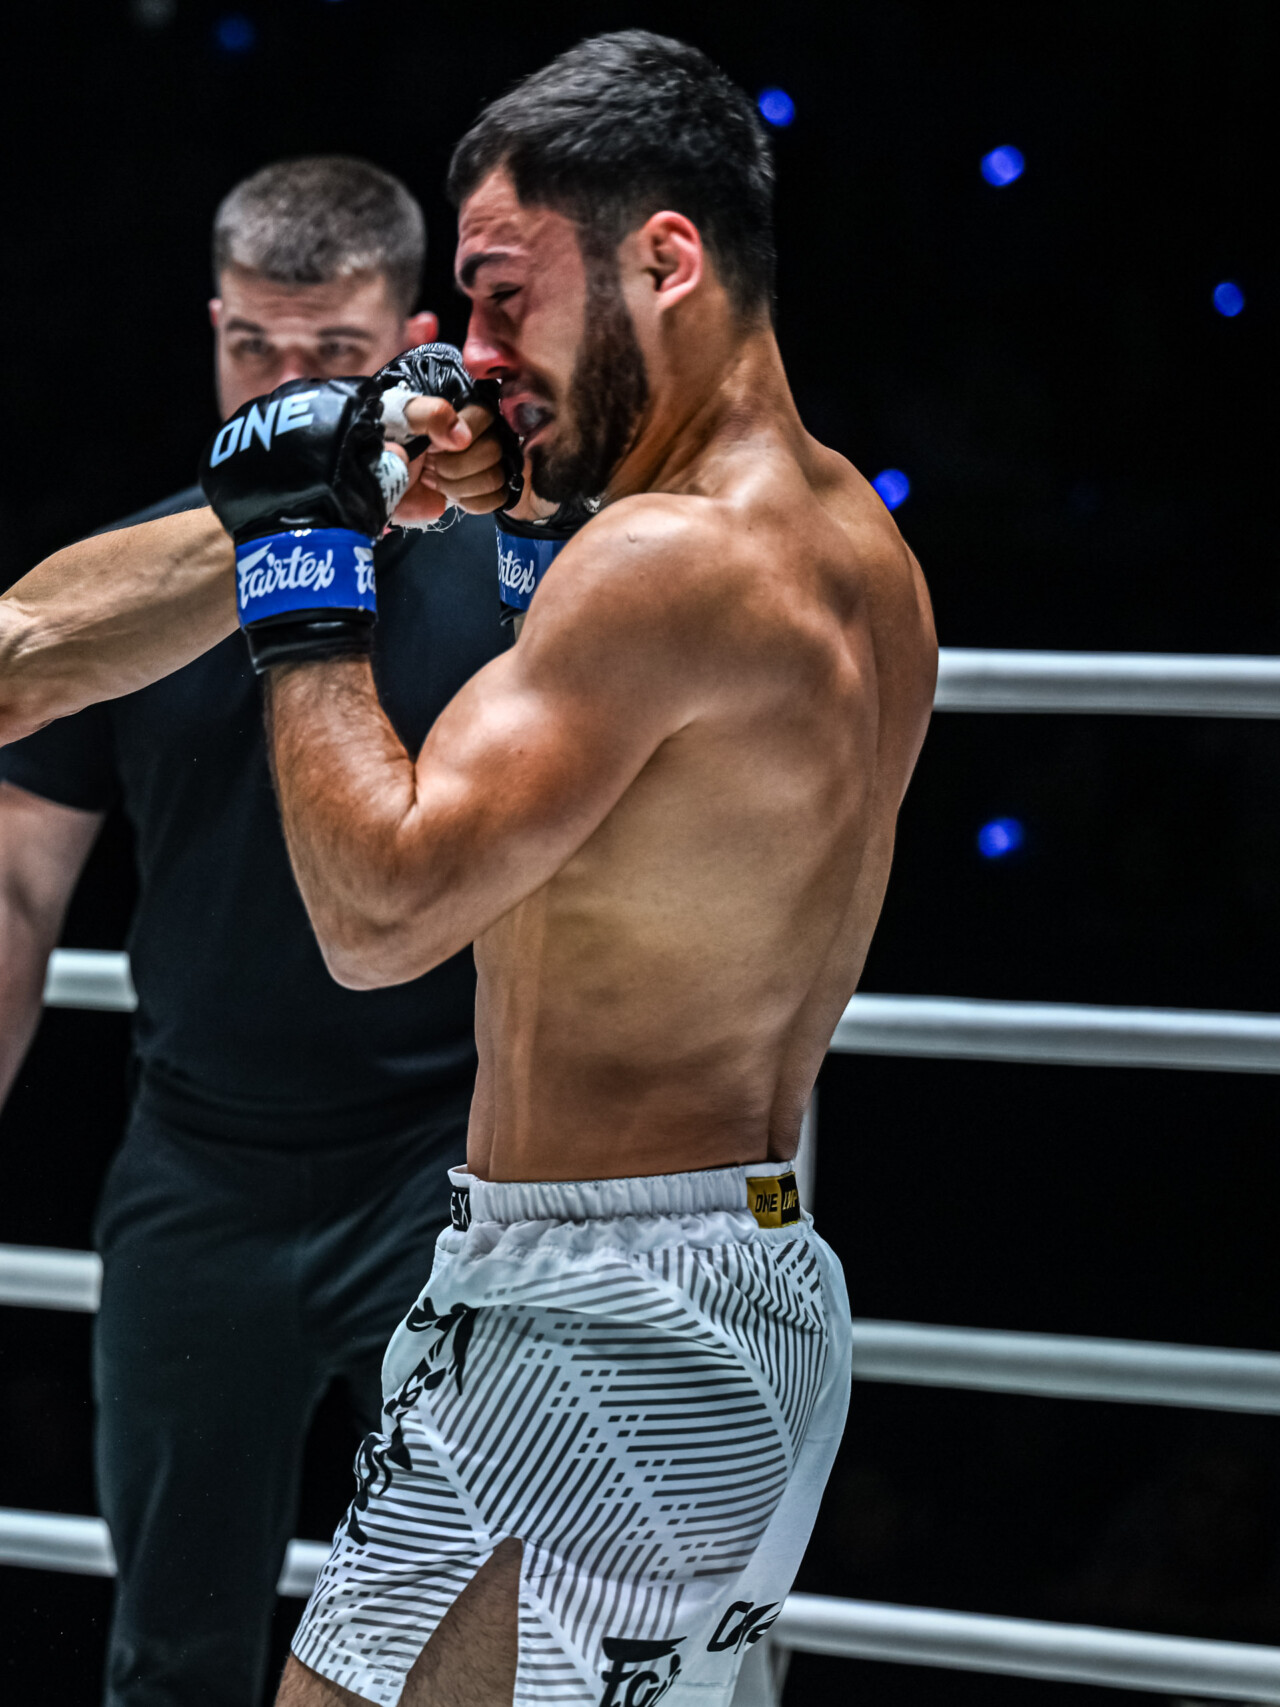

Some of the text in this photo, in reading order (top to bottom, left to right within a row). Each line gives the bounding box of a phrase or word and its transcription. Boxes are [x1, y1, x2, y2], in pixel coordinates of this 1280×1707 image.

[209, 390, 321, 468] ONE
[236, 542, 335, 608] Fairtex
[755, 1191, 778, 1213] ONE
